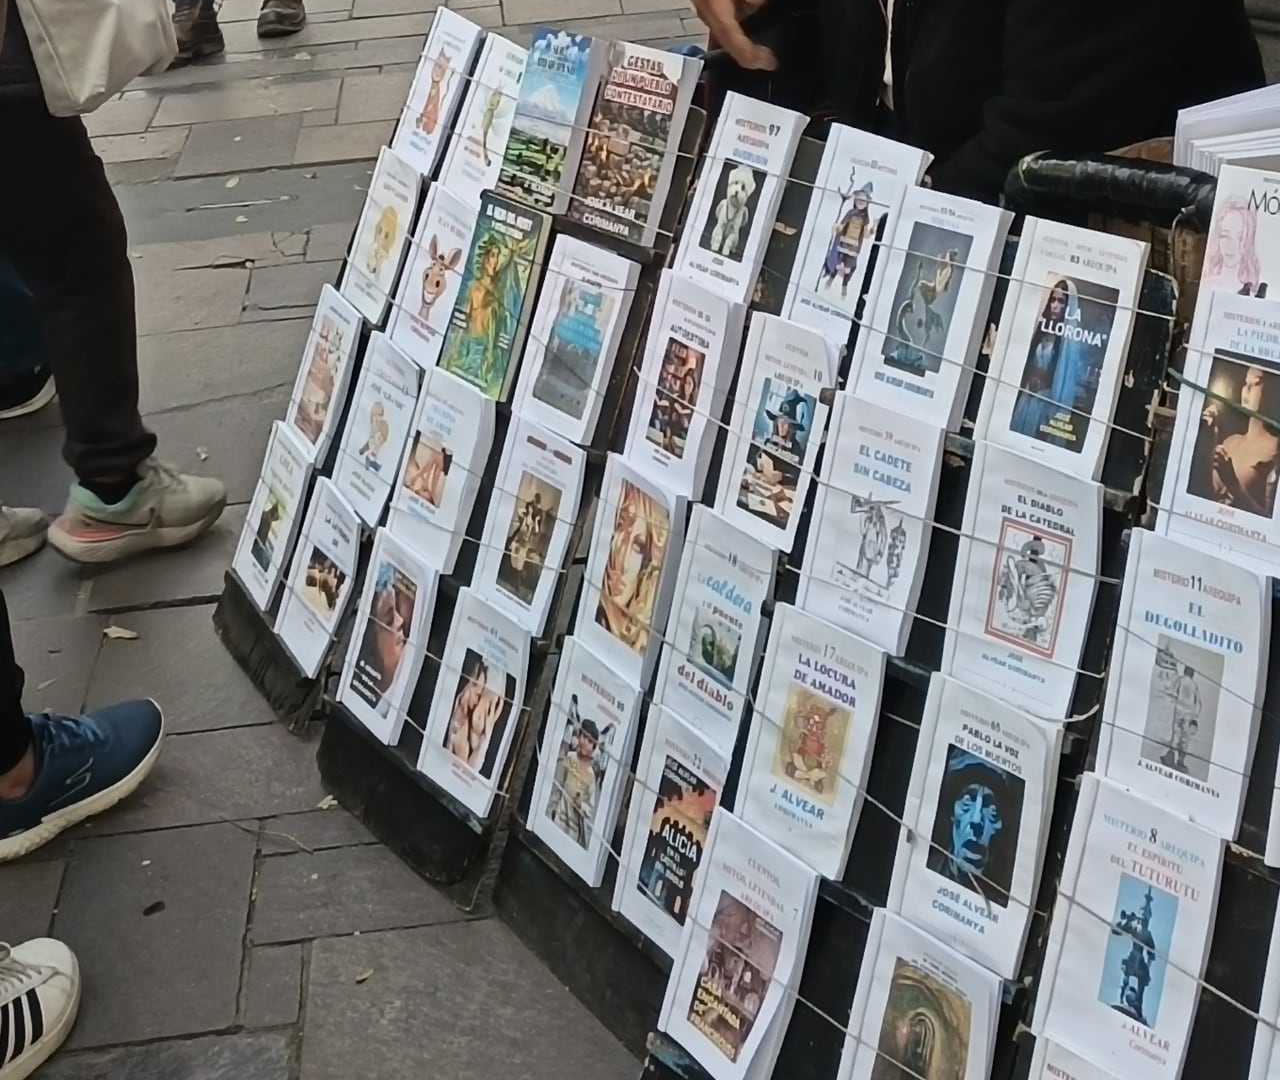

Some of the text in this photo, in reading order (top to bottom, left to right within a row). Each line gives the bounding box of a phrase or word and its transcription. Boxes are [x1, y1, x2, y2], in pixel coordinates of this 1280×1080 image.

[1065, 306, 1081, 322] LA
[859, 444, 912, 473] EL CADETE
[853, 462, 912, 494] SIN CABEZA
[1001, 504, 1076, 537] DE LA CATEDRAL
[1018, 494, 1064, 518] EL DIABLO
[706, 575, 753, 616] caldera
[1189, 575, 1203, 593] 11
[1188, 602, 1206, 618] EL
[1144, 610, 1244, 655] DEGOLLADITO
[823, 643, 837, 660] 17
[677, 664, 697, 685] del
[696, 677, 735, 712] diablo
[793, 668, 857, 708] DE AMADOR
[798, 652, 857, 691] LA LOCURA
[954, 734, 1022, 775] DE LOS MUERTOS
[962, 723, 1020, 760] PABLO LA VOZ
[781, 788, 825, 820] ALVEAR
[661, 824, 699, 863] ALICIA
[1103, 813, 1206, 869] MISTERIO 8 AREQUIPA
[1127, 841, 1139, 853] EL
[1110, 854, 1200, 902] DEL TUTURUTU
[931, 899, 986, 935] CORIMANYA
[936, 885, 1000, 925] JOSÉ ALVEAR
[1129, 1025, 1170, 1052] ALVEAR
